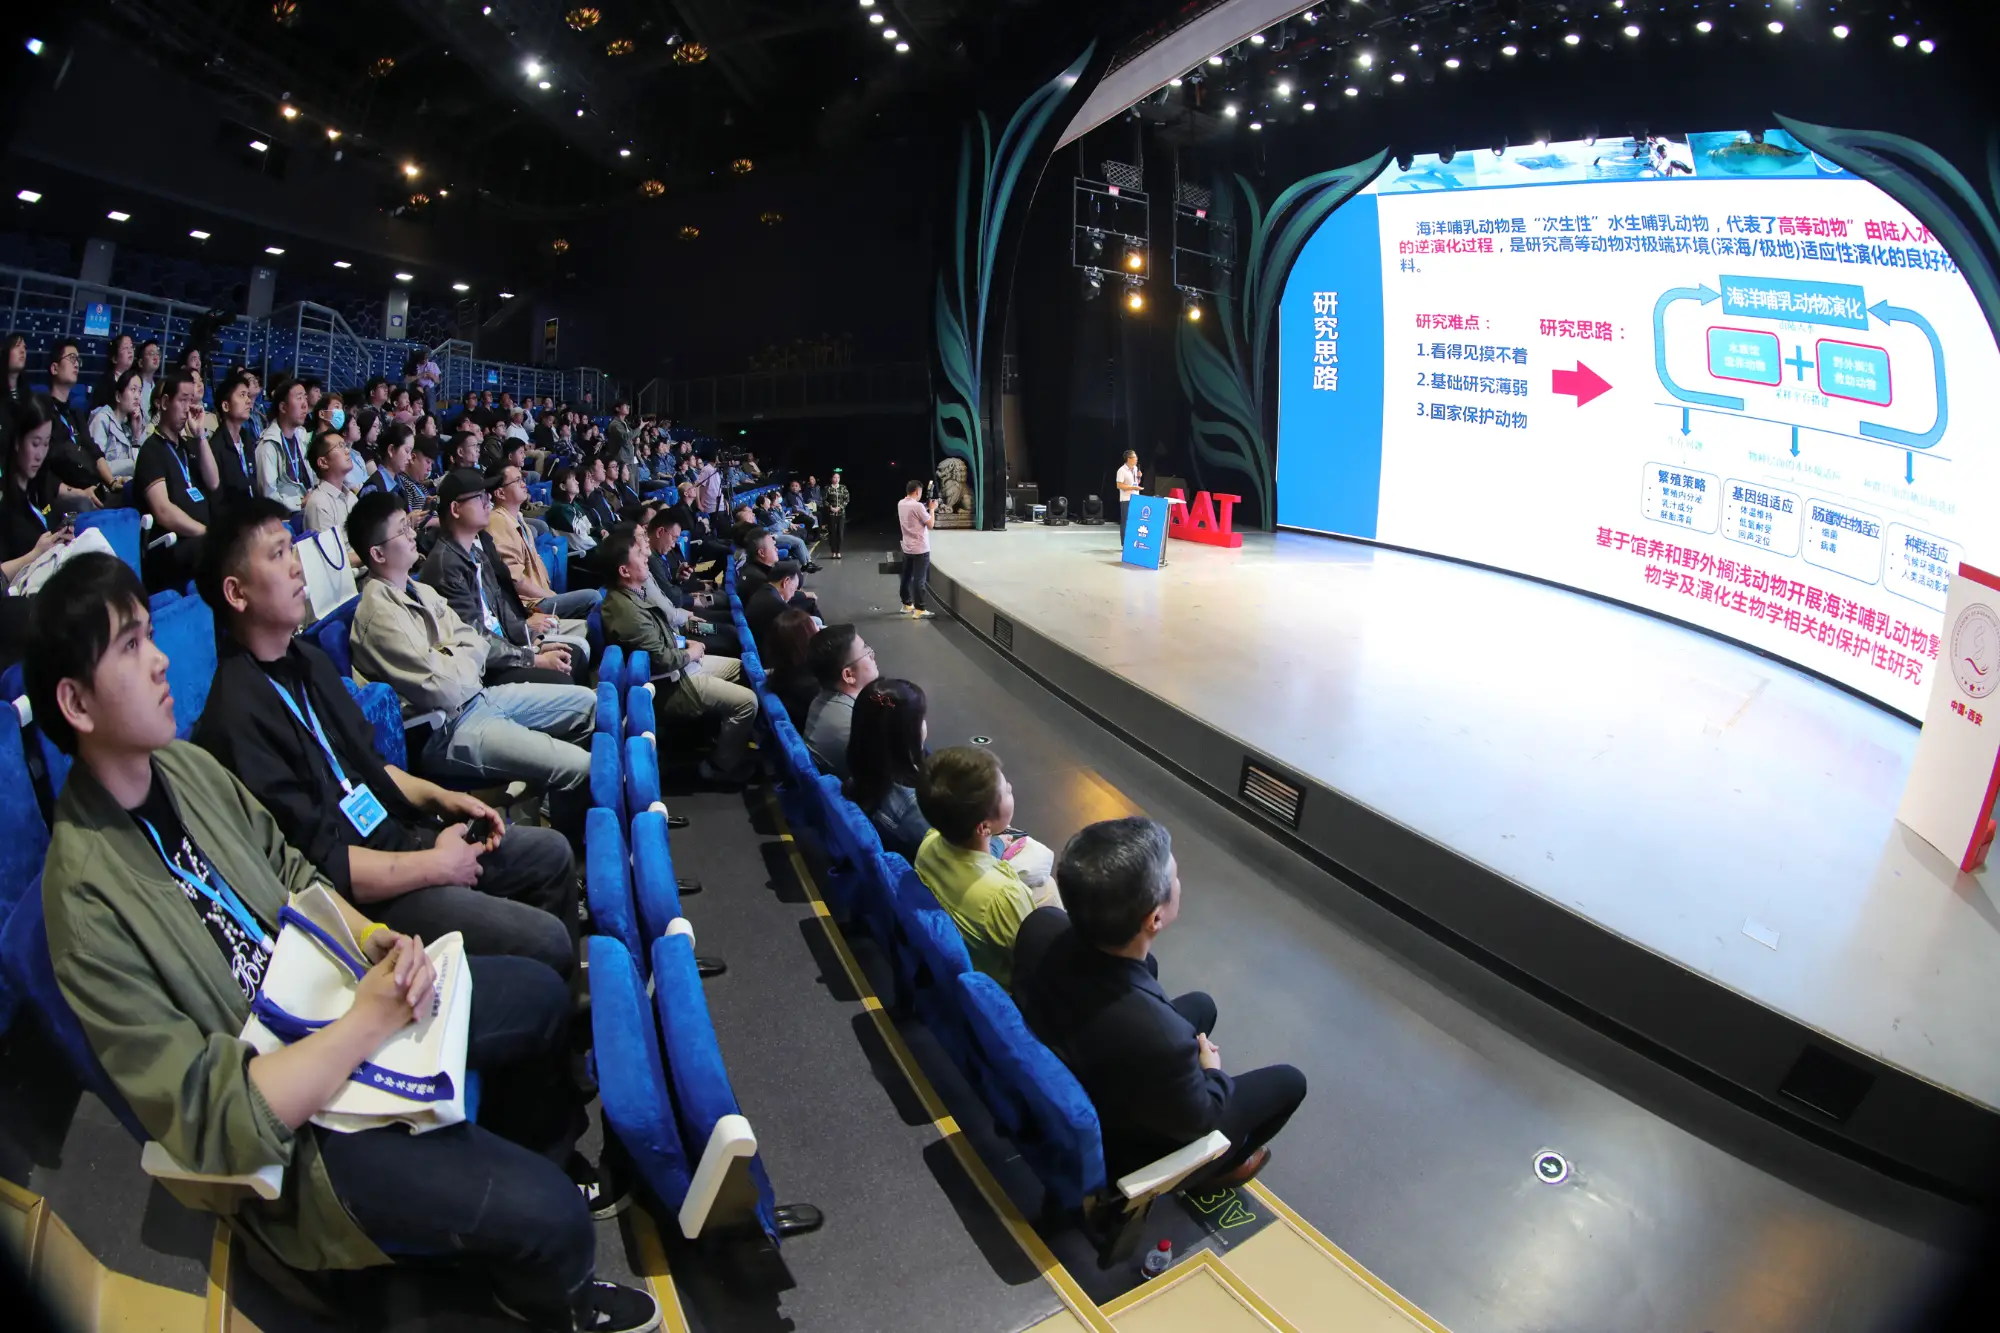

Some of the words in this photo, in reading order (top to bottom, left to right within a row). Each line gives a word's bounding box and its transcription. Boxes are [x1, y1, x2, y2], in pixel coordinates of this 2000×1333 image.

[1726, 286, 1864, 320] 海洋哺乳动物演化
[1415, 313, 1491, 331] 研究难点：
[1539, 318, 1626, 341] 研究思路：
[1313, 291, 1339, 392] 研究思路
[1417, 342, 1528, 365] 1.看得见摸不着
[1417, 372, 1528, 396] 2.基础研究薄弱
[1416, 402, 1528, 429] 3.国家保护动物
[1658, 470, 1706, 492] 繁殖策略
[1732, 486, 1794, 514] 基因组适应
[1812, 506, 1880, 539] 肠道微生物适应
[1904, 534, 1949, 564] 种群适应
[1644, 564, 1923, 686] 物学及演化生物学相关的保护性研究
